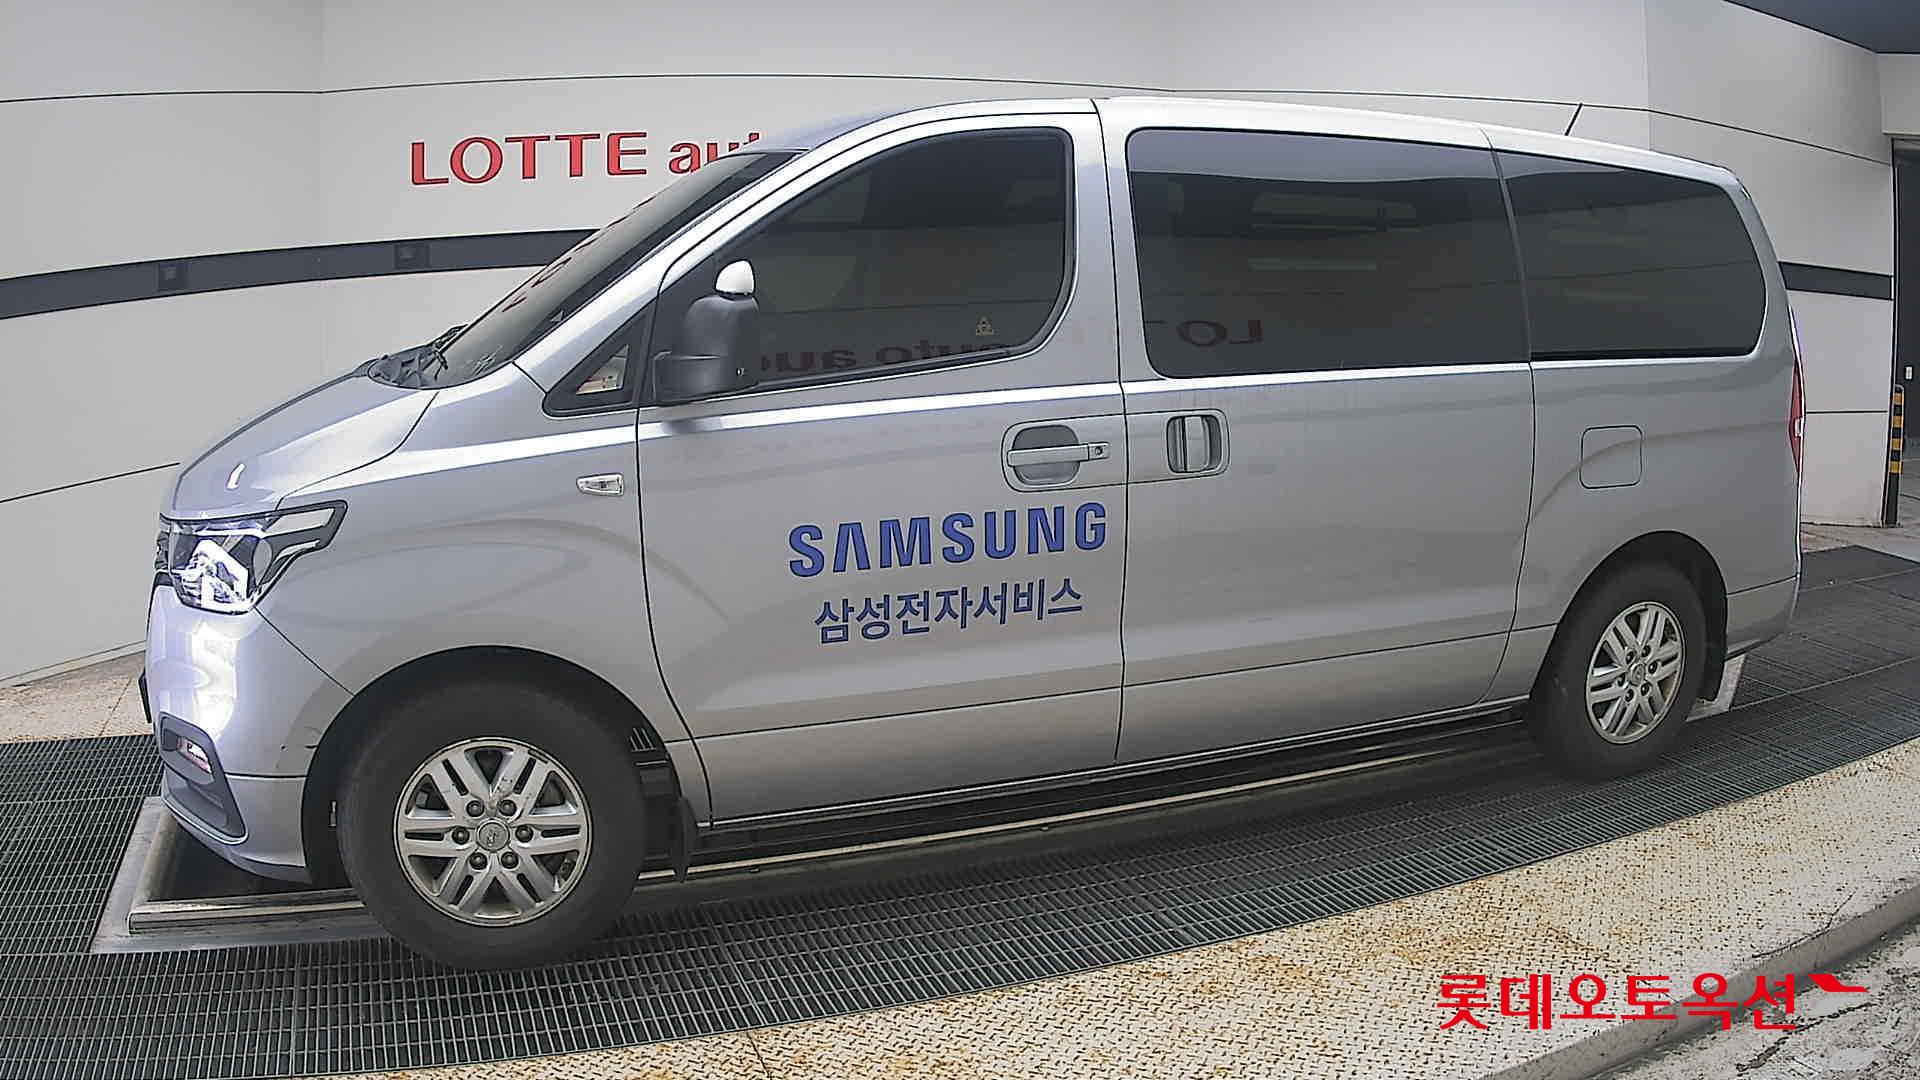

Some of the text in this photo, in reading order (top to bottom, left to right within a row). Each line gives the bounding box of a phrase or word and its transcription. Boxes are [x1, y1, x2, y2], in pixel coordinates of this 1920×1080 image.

[411, 132, 647, 185] LOTTE
[788, 502, 1106, 577] SAMSUNG
[815, 578, 1083, 644] 삼성전자서비스
